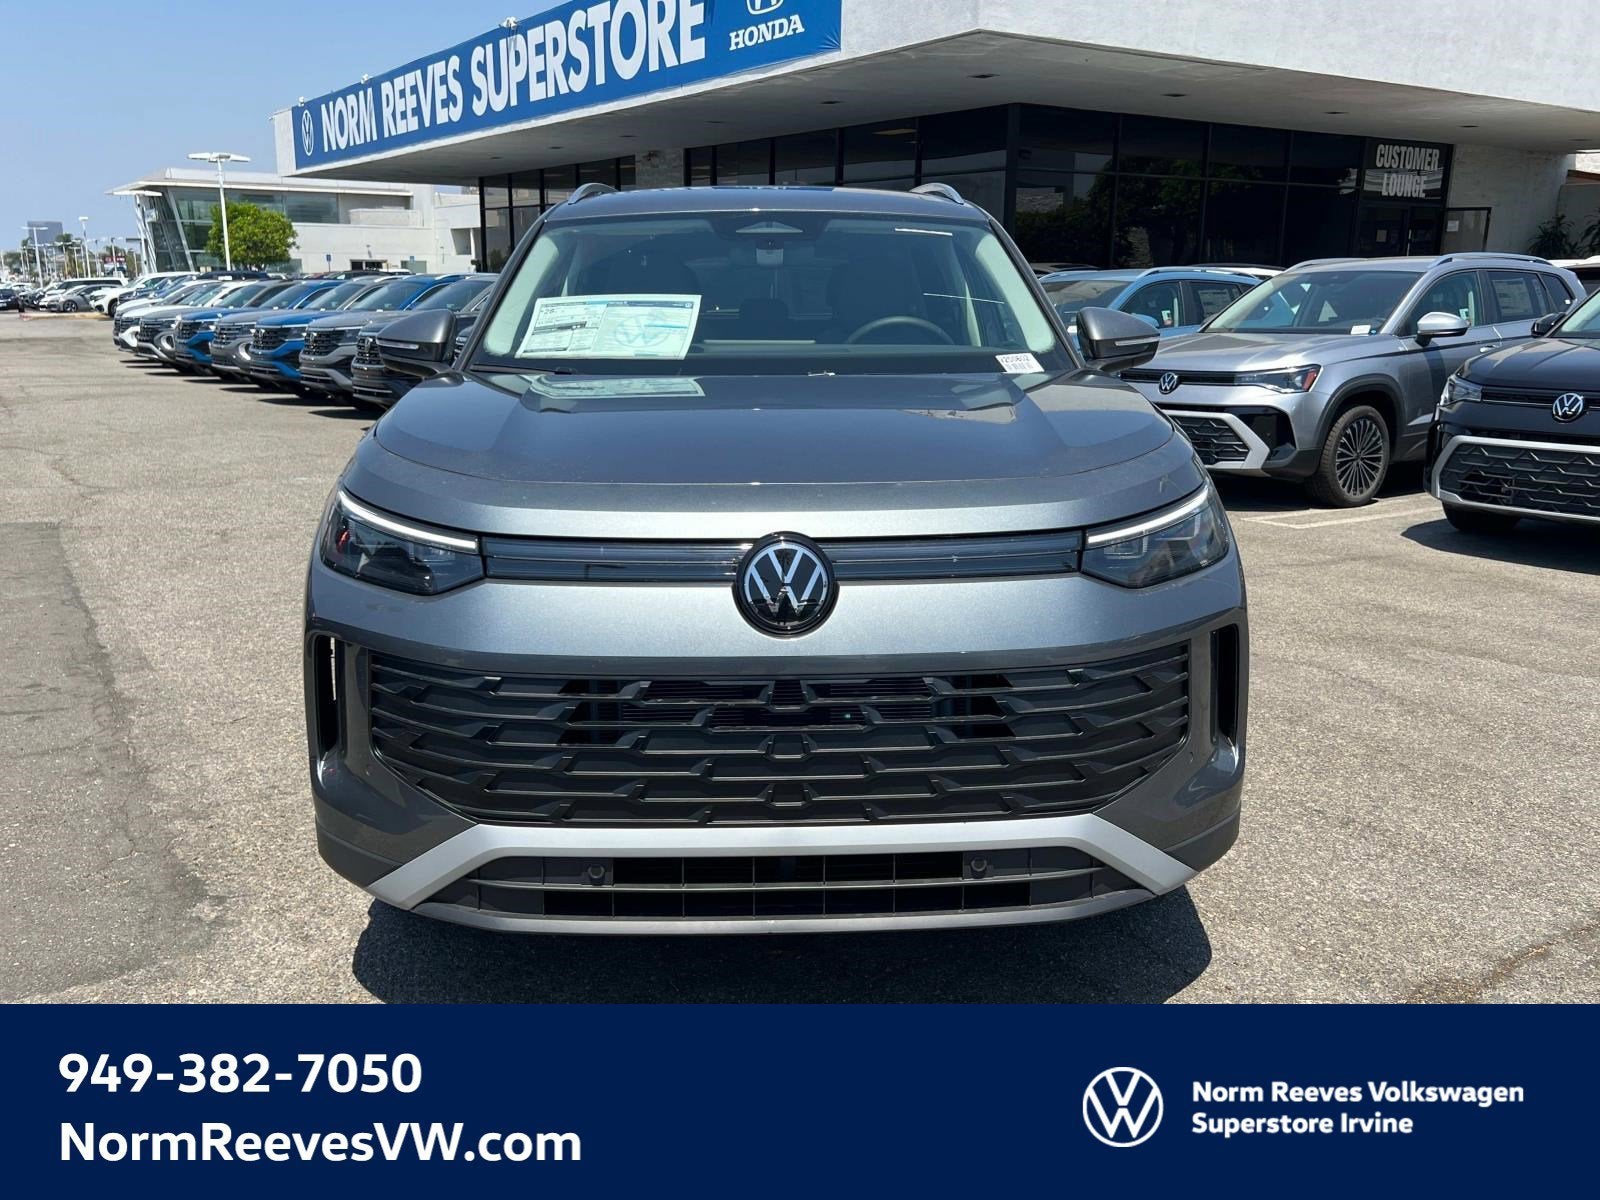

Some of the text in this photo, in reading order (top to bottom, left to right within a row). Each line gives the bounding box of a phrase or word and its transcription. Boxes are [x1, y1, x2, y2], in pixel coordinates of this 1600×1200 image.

[729, 14, 805, 51] HONDA
[320, 0, 706, 153] NORM REEVES SUPERSTORE
[1375, 144, 1441, 171] CUSTOMER
[1381, 172, 1428, 198] LOUNGE
[744, 542, 828, 625] VW
